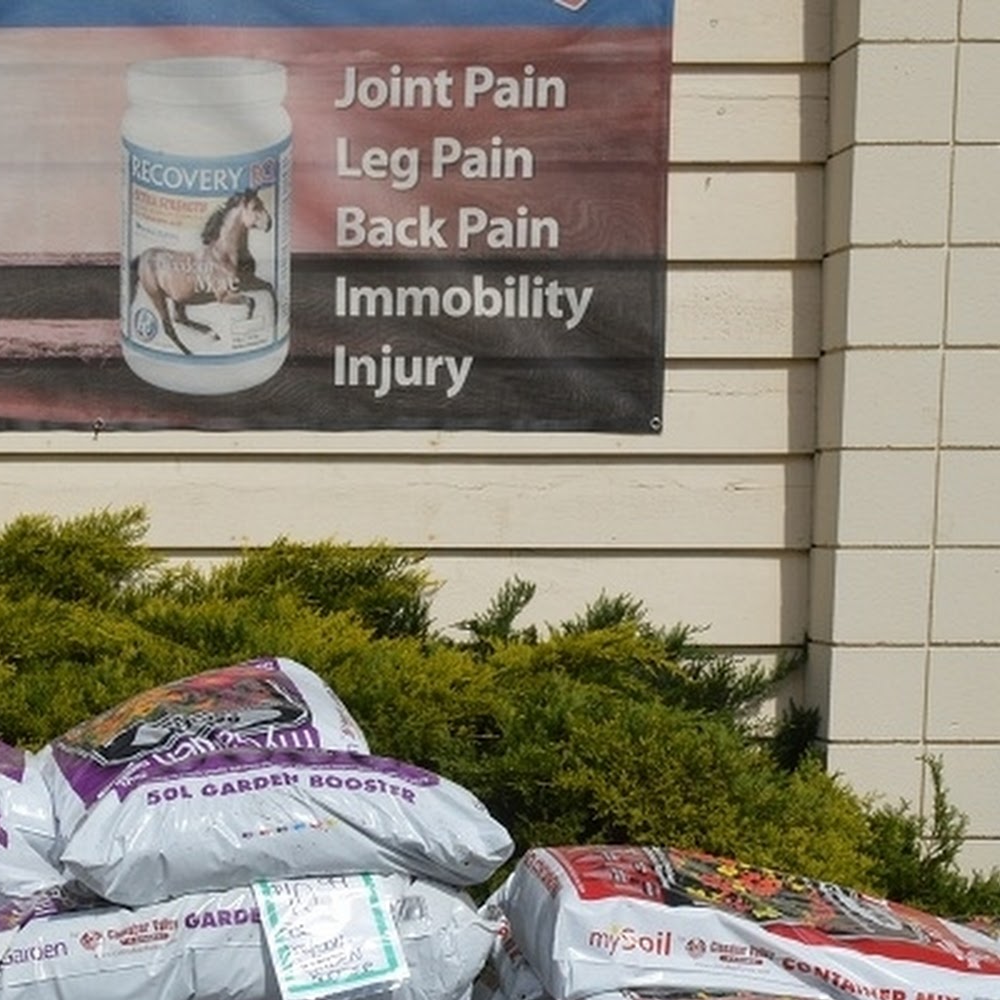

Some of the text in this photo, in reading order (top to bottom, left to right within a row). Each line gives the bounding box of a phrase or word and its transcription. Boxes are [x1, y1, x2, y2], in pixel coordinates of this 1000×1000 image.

[334, 64, 566, 108] Joint Pain
[132, 155, 243, 191] RECOVERY
[336, 136, 533, 190] Leg Pain
[336, 206, 559, 249] Back Pain
[334, 275, 595, 330] Immobility
[333, 344, 473, 398] Injury
[147, 774, 418, 806] 50L GARDEN BOOSTER
[185, 907, 263, 931] GARDE
[589, 927, 671, 956] mySoil
